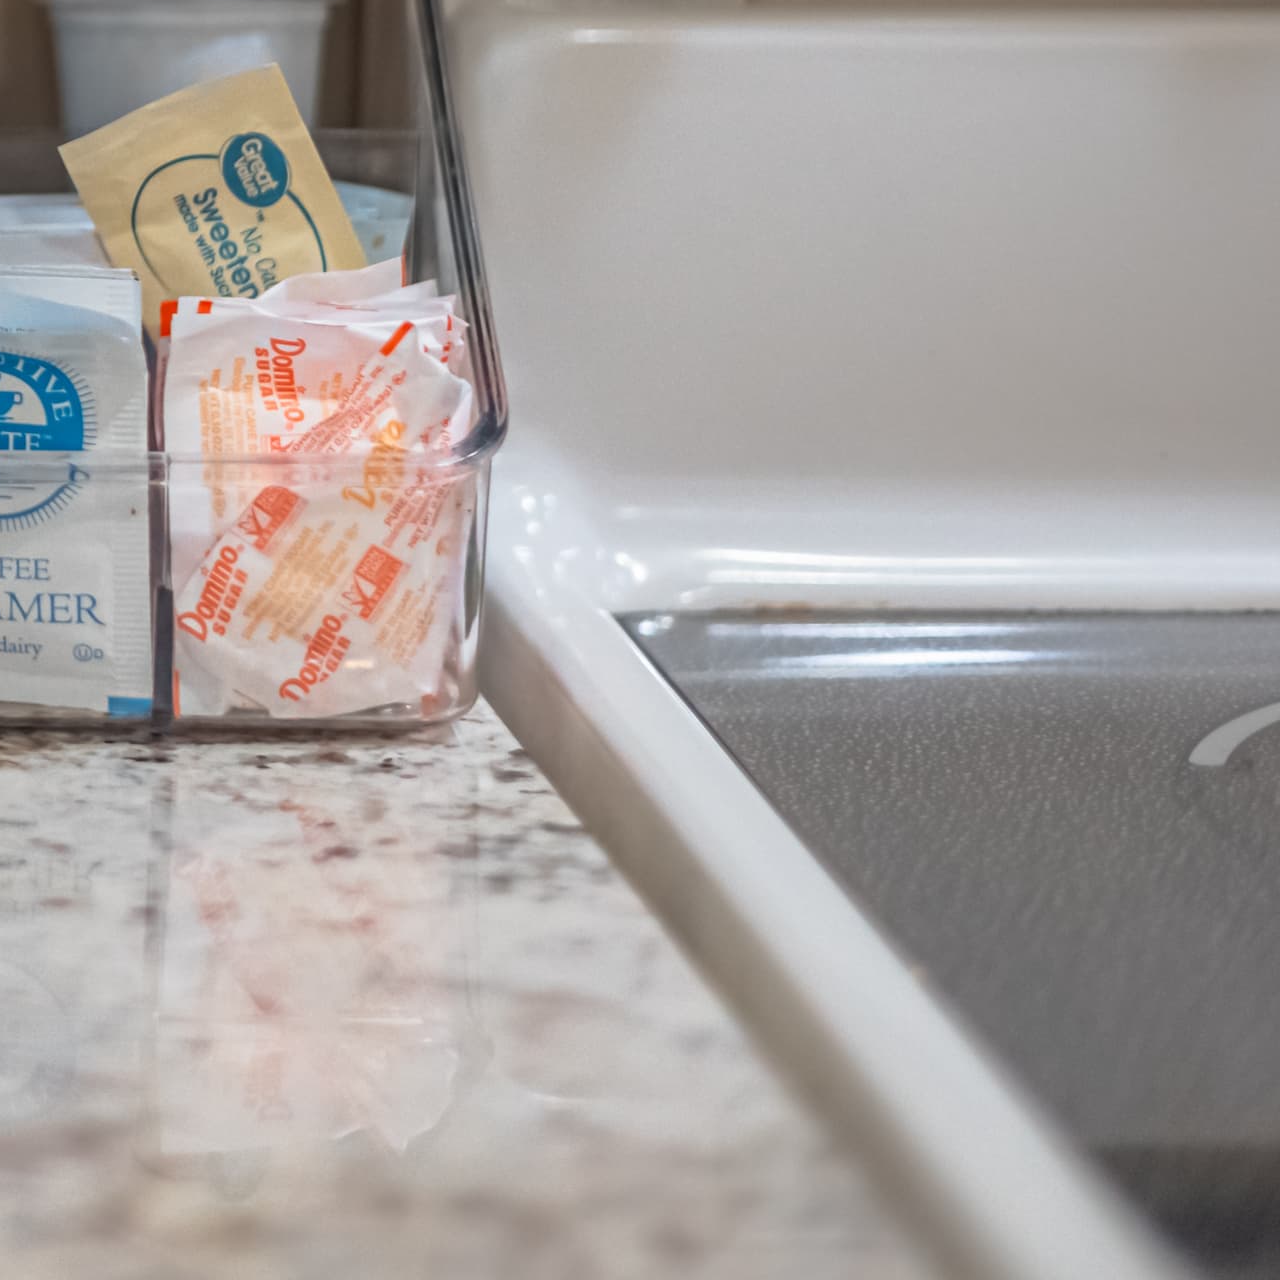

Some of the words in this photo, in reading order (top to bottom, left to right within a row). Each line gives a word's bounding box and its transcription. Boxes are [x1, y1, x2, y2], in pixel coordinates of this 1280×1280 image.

[233, 156, 260, 199] Value
[242, 138, 279, 194] Great
[173, 193, 200, 234] made
[195, 234, 217, 267] with
[241, 226, 264, 255] No
[254, 347, 280, 412] SUGAR
[269, 336, 307, 423] Domino
[176, 545, 239, 644] Domino
[212, 568, 249, 637] SUGAR
